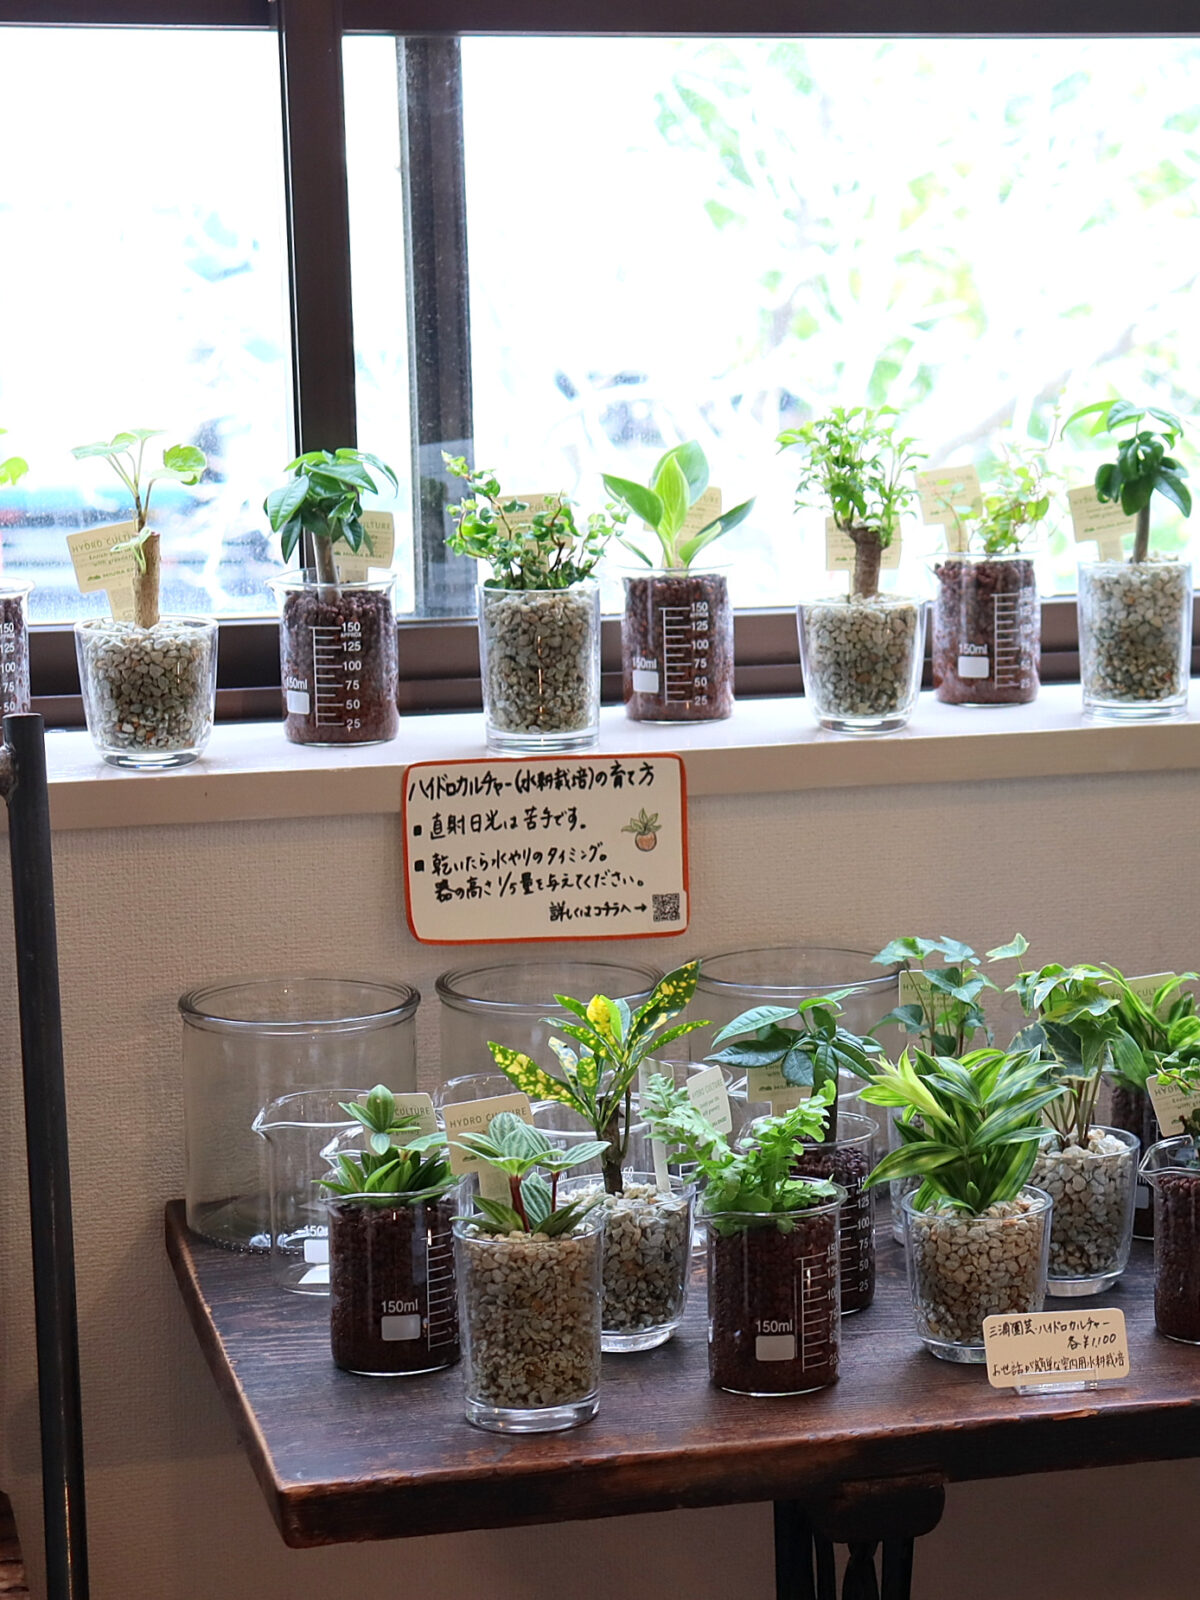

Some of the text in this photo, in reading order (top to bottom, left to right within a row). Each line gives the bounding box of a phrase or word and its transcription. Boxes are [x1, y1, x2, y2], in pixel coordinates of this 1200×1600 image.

[691, 602, 708, 613] 150
[341, 621, 361, 633] 150
[692, 621, 708, 632] 125
[342, 641, 362, 652] 125
[692, 639, 709, 650] 100
[958, 643, 988, 656] 150ml
[1, 661, 16, 672] 100
[342, 661, 362, 671] 100
[694, 658, 707, 669] 75
[3, 682, 15, 693] 75
[345, 680, 360, 690] 75
[695, 677, 707, 687] 50
[345, 699, 360, 710] 50
[695, 695, 707, 706] 25
[4, 702, 15, 713] 50
[346, 718, 361, 729] 25
[1154, 1084, 1180, 1097] HYDR
[394, 1107, 431, 1117] CULTURE
[449, 1115, 482, 1129] HYDRO
[858, 1195, 870, 1209] 125
[857, 1216, 870, 1230] 100
[859, 1237, 869, 1251] 75
[859, 1258, 869, 1272] 50
[859, 1279, 869, 1292] 25
[381, 1299, 419, 1313] 150ml
[755, 1319, 793, 1333] 150ml
